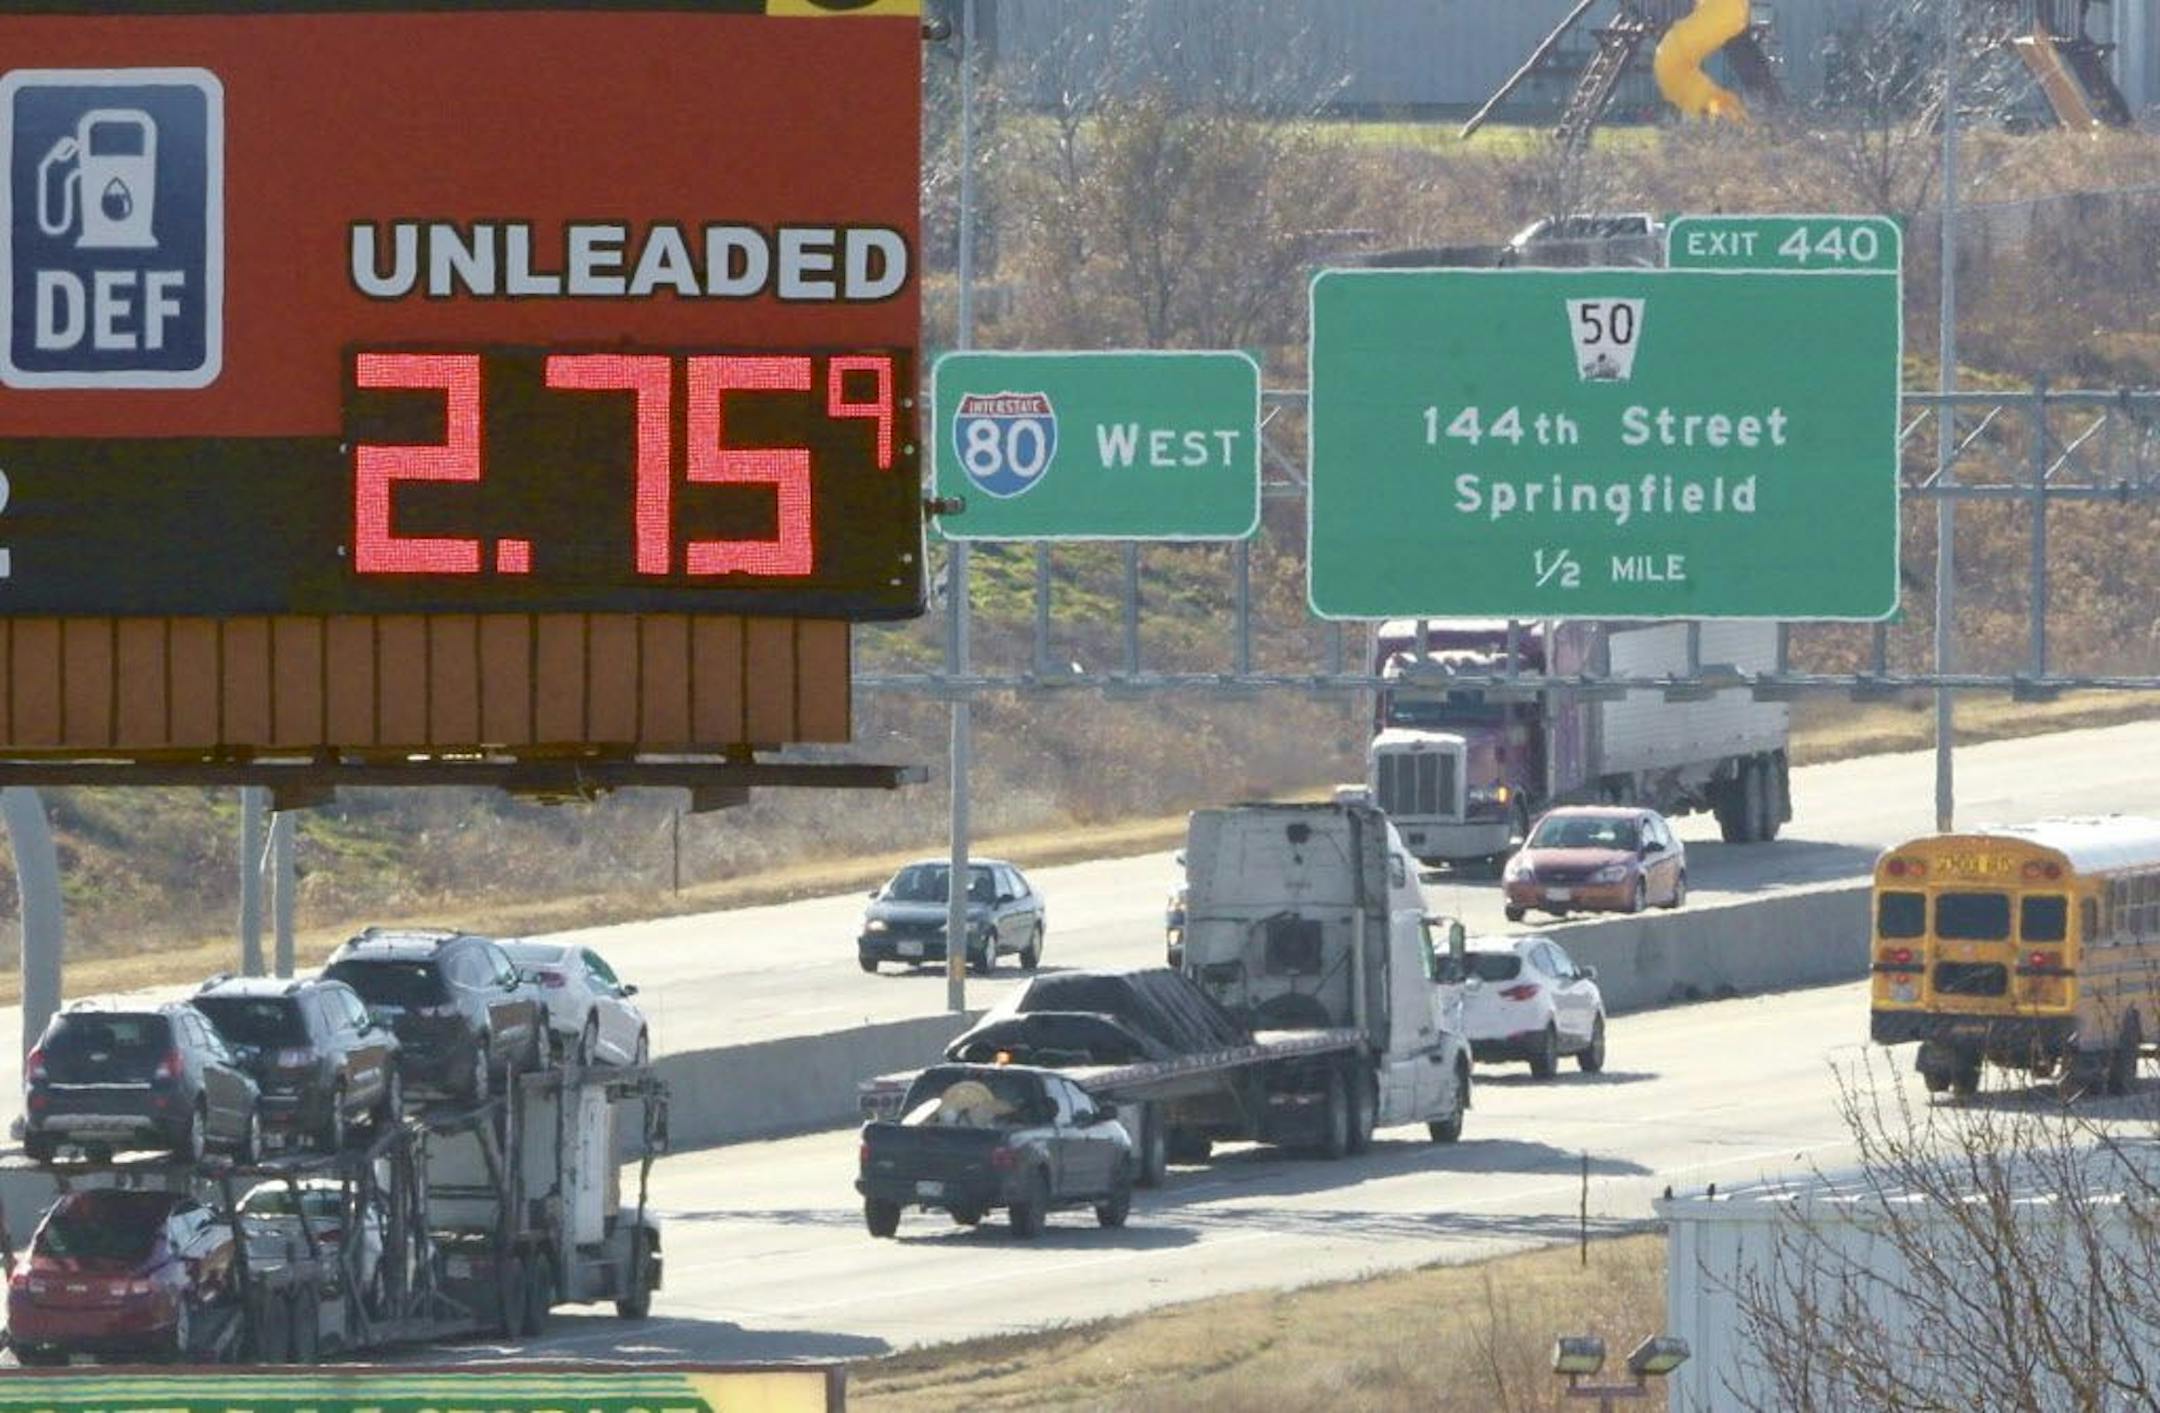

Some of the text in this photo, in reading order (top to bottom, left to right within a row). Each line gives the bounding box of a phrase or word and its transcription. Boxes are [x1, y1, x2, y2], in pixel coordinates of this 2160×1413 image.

[352, 224, 907, 299] UNLEADED
[1687, 226, 1878, 263] EXIT 440
[35, 270, 185, 350] DEF
[1580, 303, 1633, 345] 50
[968, 399, 1041, 414] INTERSTATE
[1423, 406, 1787, 446] 144th Street
[965, 418, 1046, 477] 80
[1096, 423, 1240, 468] WEST
[1454, 474, 1756, 526] Springfield
[1611, 555, 1687, 581] MILE
